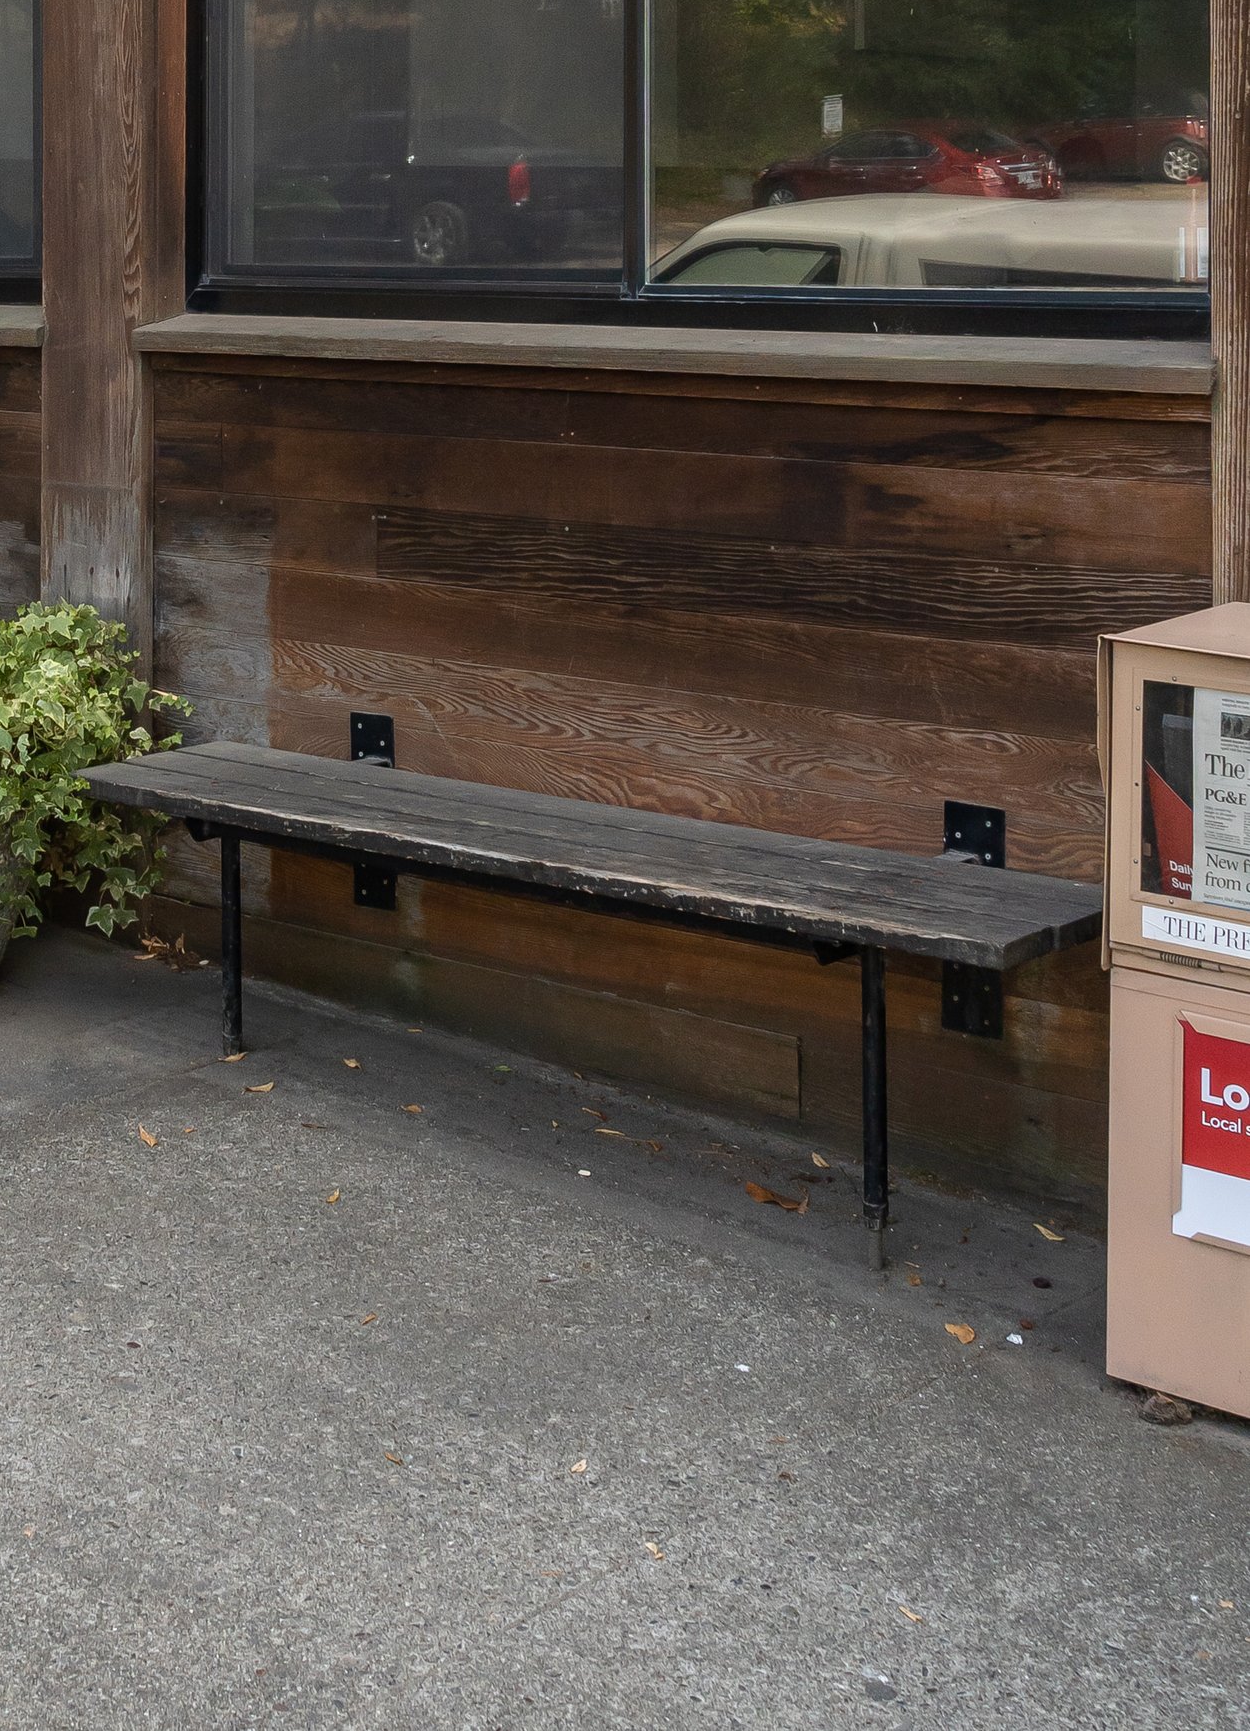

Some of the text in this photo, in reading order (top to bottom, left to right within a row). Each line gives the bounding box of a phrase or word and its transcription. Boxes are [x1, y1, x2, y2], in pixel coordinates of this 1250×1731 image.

[1205, 753, 1245, 780] The
[1205, 787, 1247, 806] PG&E
[1206, 852, 1239, 871] New
[1205, 870, 1241, 891] from
[1163, 915, 1206, 943] THE
[1201, 1067, 1250, 1111] Lo
[1202, 1110, 1241, 1134] Local
